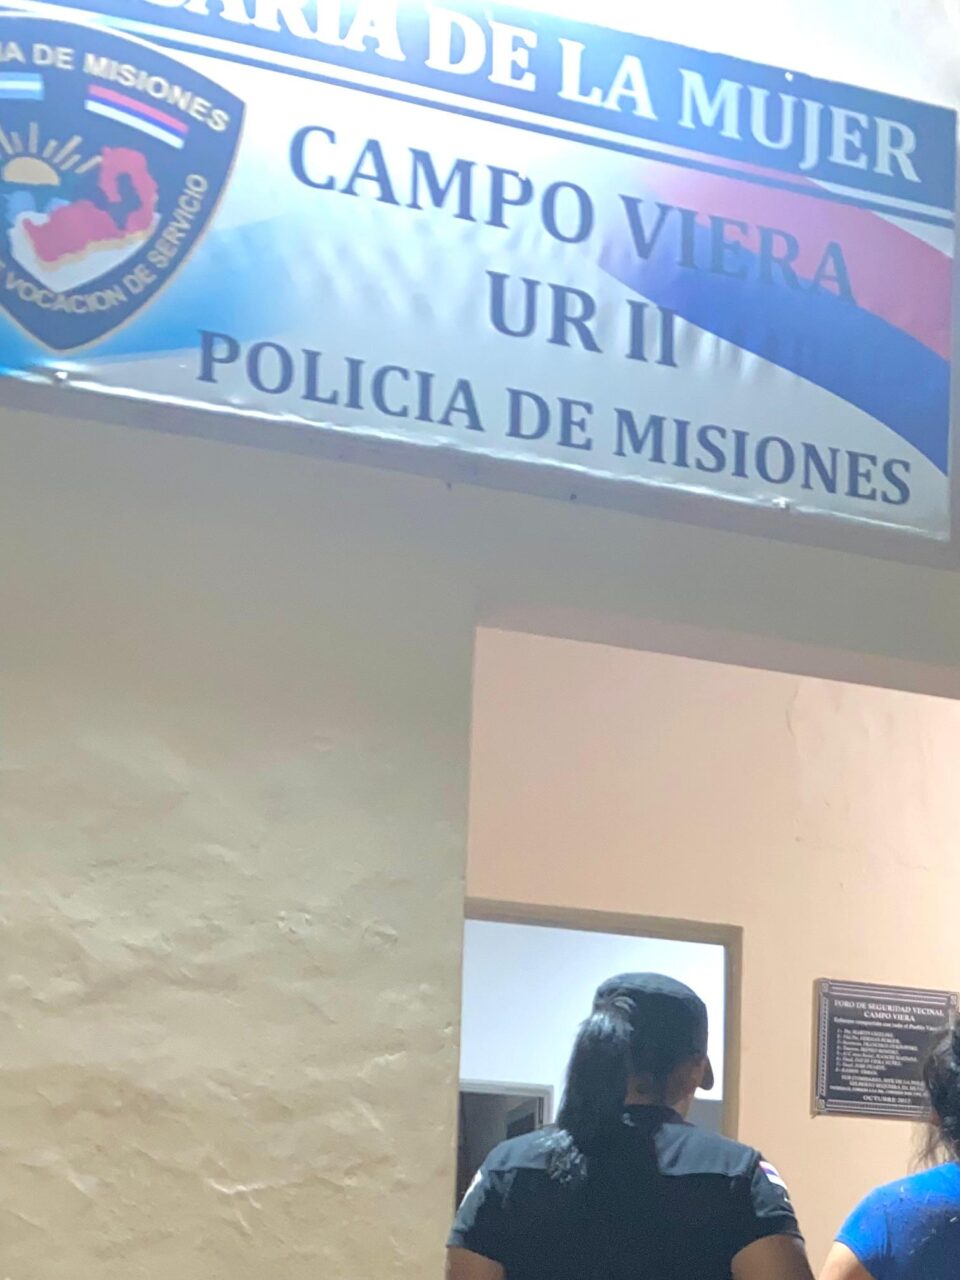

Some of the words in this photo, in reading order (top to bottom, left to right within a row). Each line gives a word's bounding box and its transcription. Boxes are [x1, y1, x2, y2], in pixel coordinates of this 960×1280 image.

[32, 43, 75, 71] DE
[83, 52, 230, 132] MISIONES
[424, 4, 538, 92] DE
[557, 37, 659, 121] LA
[677, 67, 921, 183] MUJER
[123, 263, 157, 294] DE
[147, 174, 208, 268] SERVICIO
[289, 125, 595, 244] CAMPO
[618, 193, 858, 306] VIERA
[485, 270, 603, 354] UR
[625, 298, 679, 368] II
[196, 329, 485, 432] POLICIA
[506, 387, 594, 451] DE
[613, 407, 911, 505] MISIONES
[856, 1001, 866, 1009] DE
[867, 1003, 911, 1013] SEGURIDAD
[912, 1006, 945, 1017] VECINAL
[864, 1011, 892, 1020] CAMPO
[892, 1013, 916, 1023] VIERA
